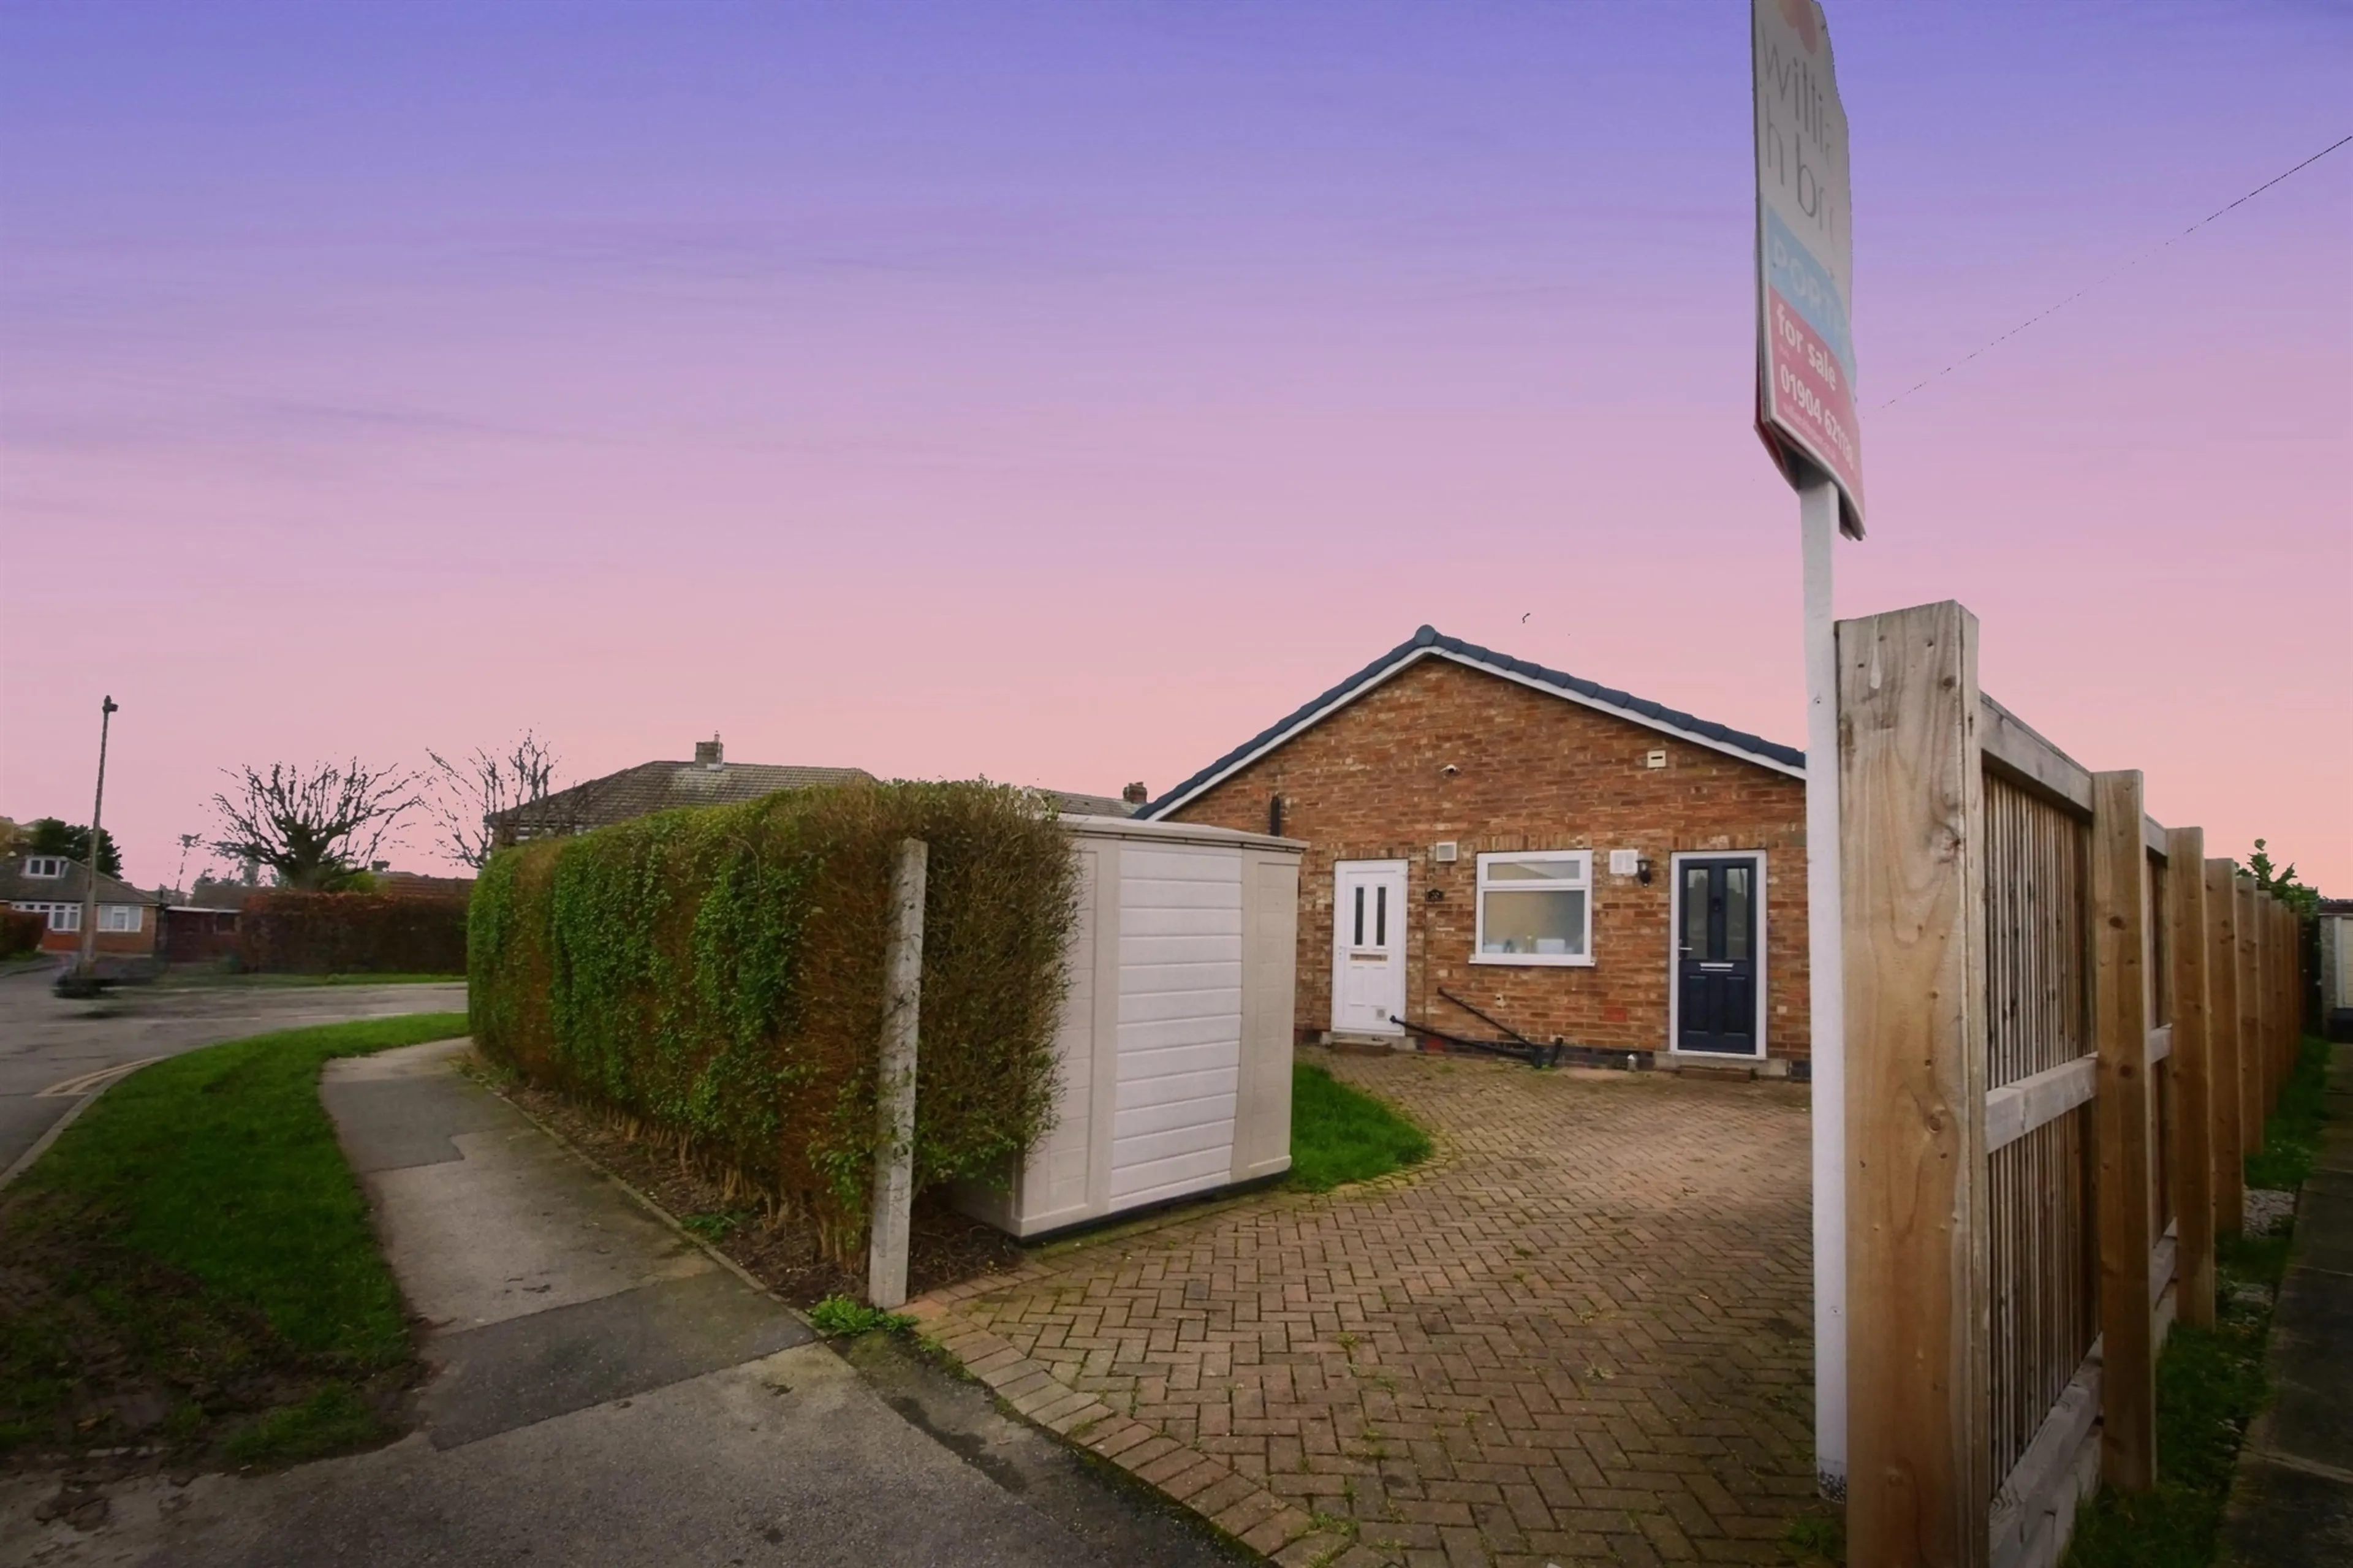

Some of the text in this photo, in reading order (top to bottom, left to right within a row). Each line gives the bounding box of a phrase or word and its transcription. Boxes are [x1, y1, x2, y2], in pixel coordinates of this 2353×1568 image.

[1766, 93, 1784, 187] h
[1776, 303, 1804, 354] for
[1807, 343, 1836, 392] sale
[1781, 363, 1822, 425] 01904
